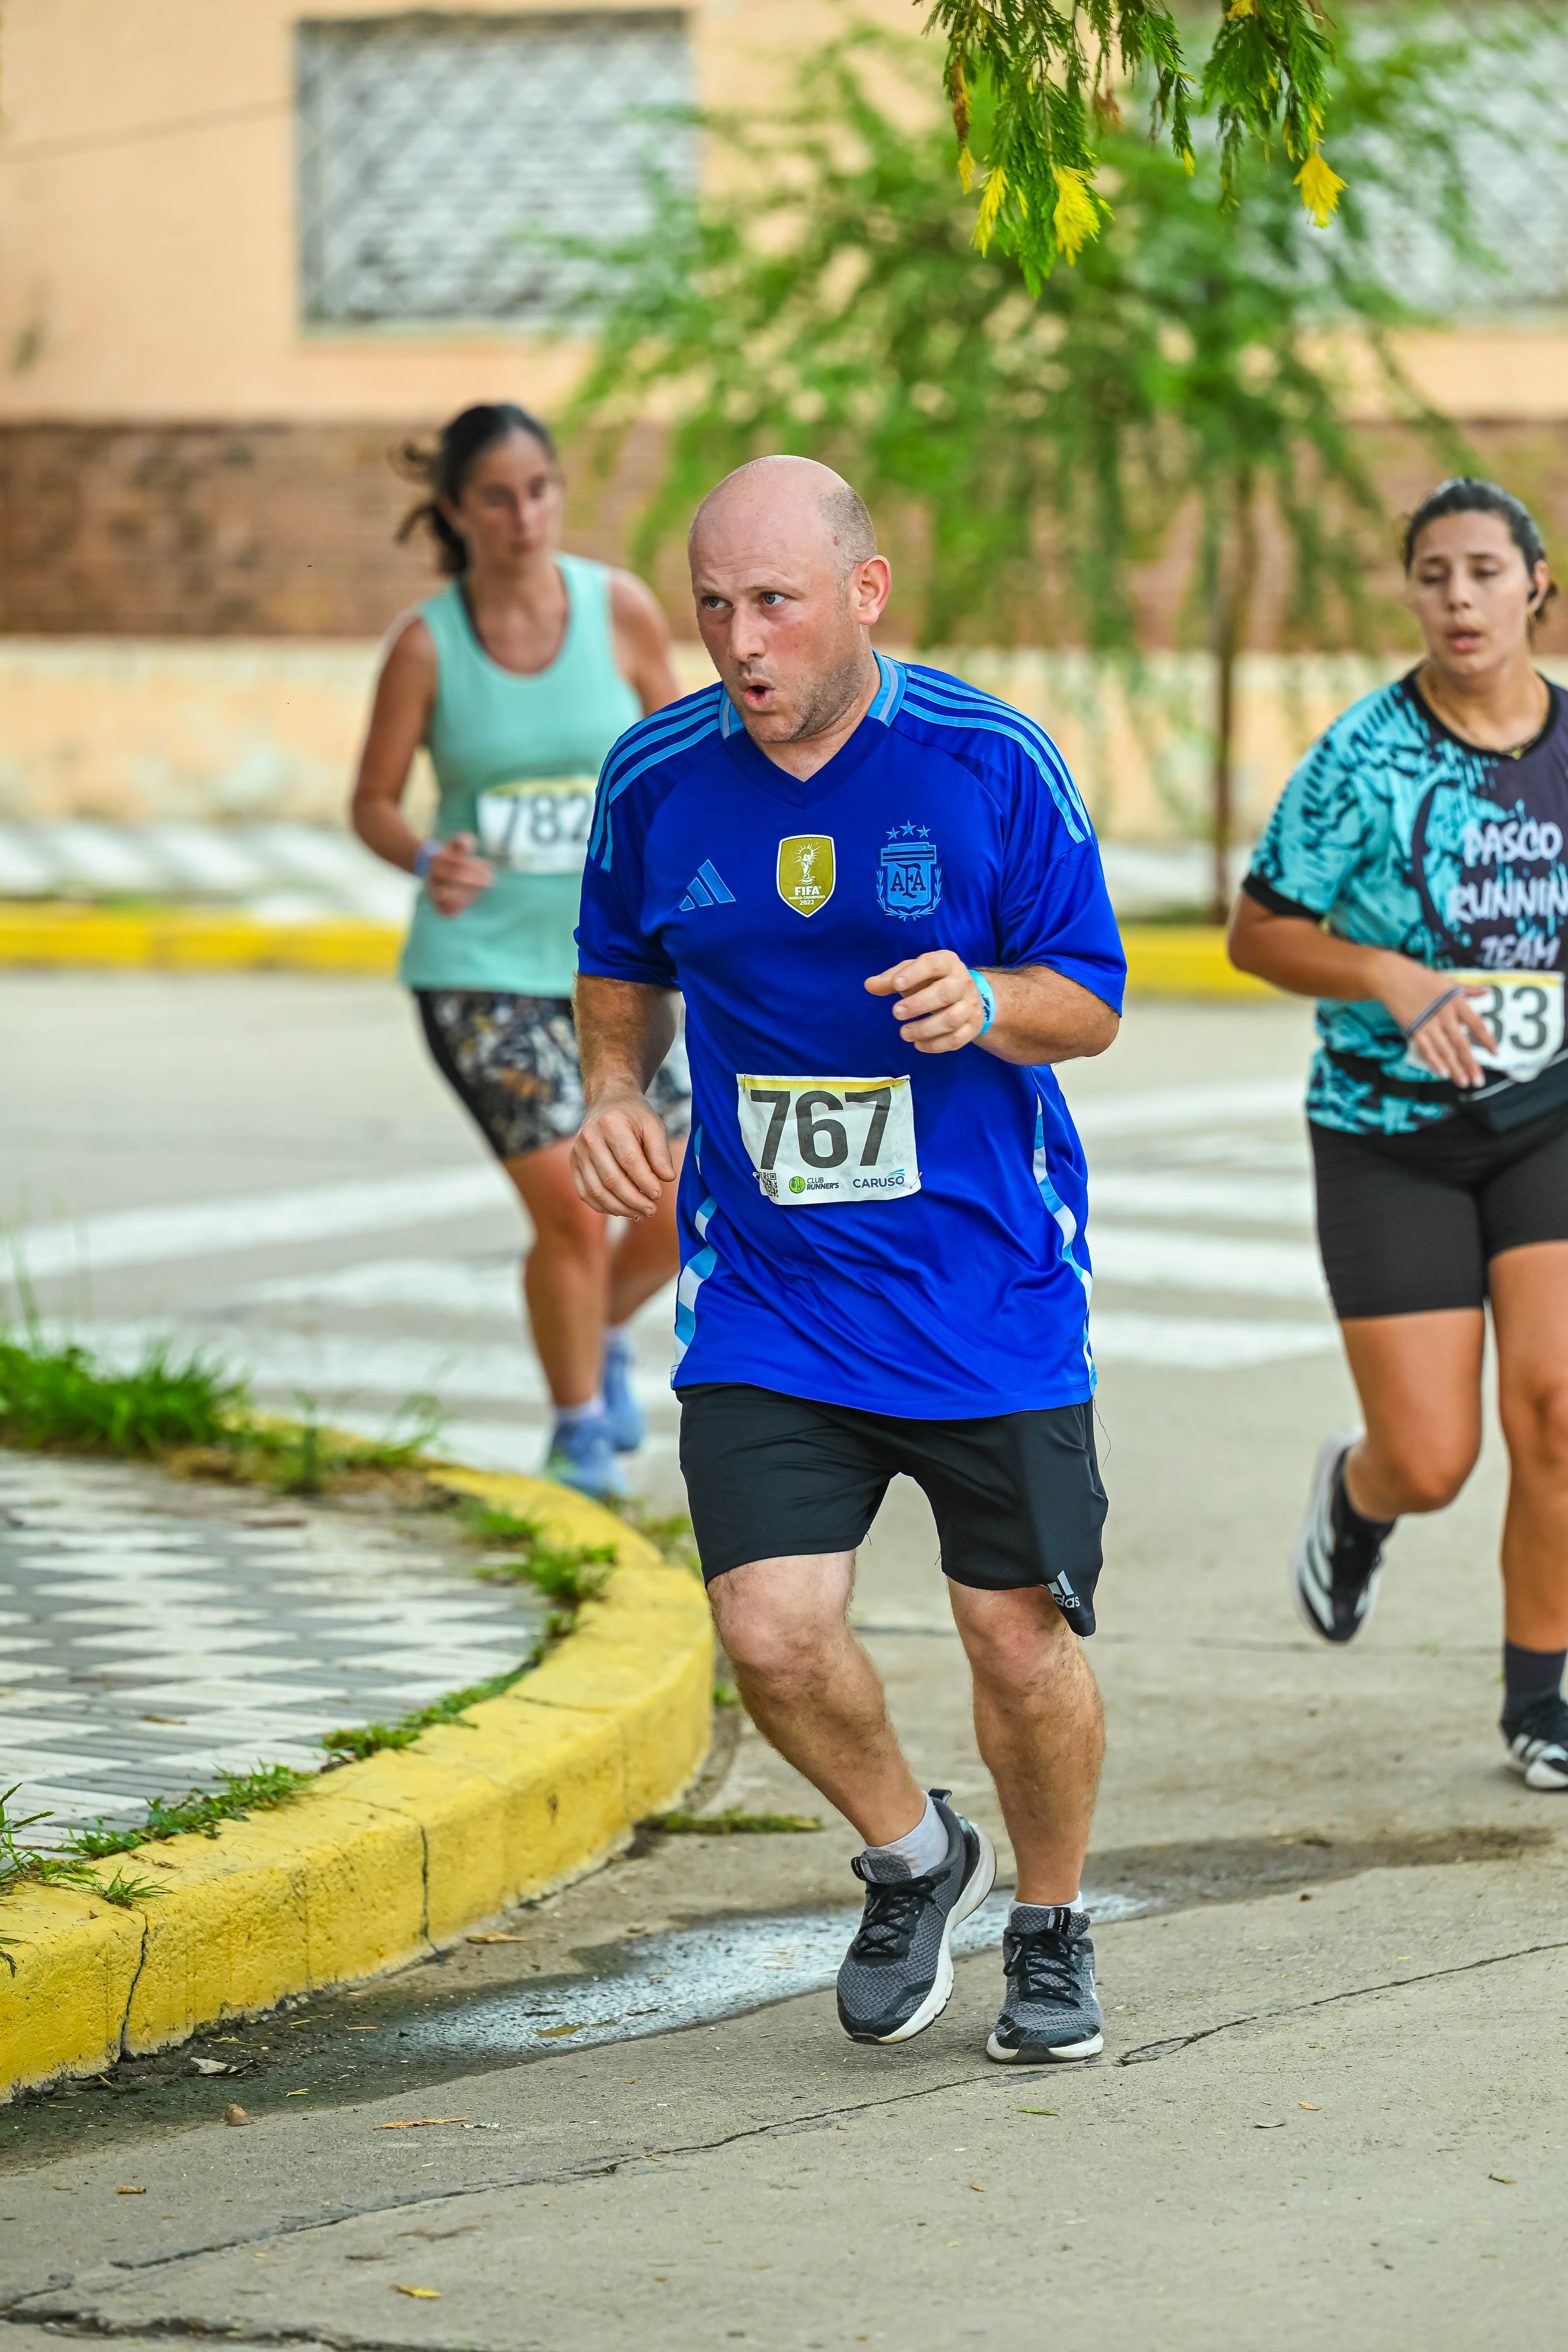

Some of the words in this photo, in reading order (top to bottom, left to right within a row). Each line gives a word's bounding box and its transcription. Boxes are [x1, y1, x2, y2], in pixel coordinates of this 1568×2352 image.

[1462, 819, 1564, 868] PASCO
[794, 886, 820, 896] FIFA
[890, 862, 927, 899] AFA
[1480, 933, 1561, 968] TEAM
[751, 1087, 892, 1170] 767
[806, 1182, 839, 1190] RUNNER'S
[852, 1176, 905, 1188] CARUSO
[1052, 1595, 1080, 1608] das
